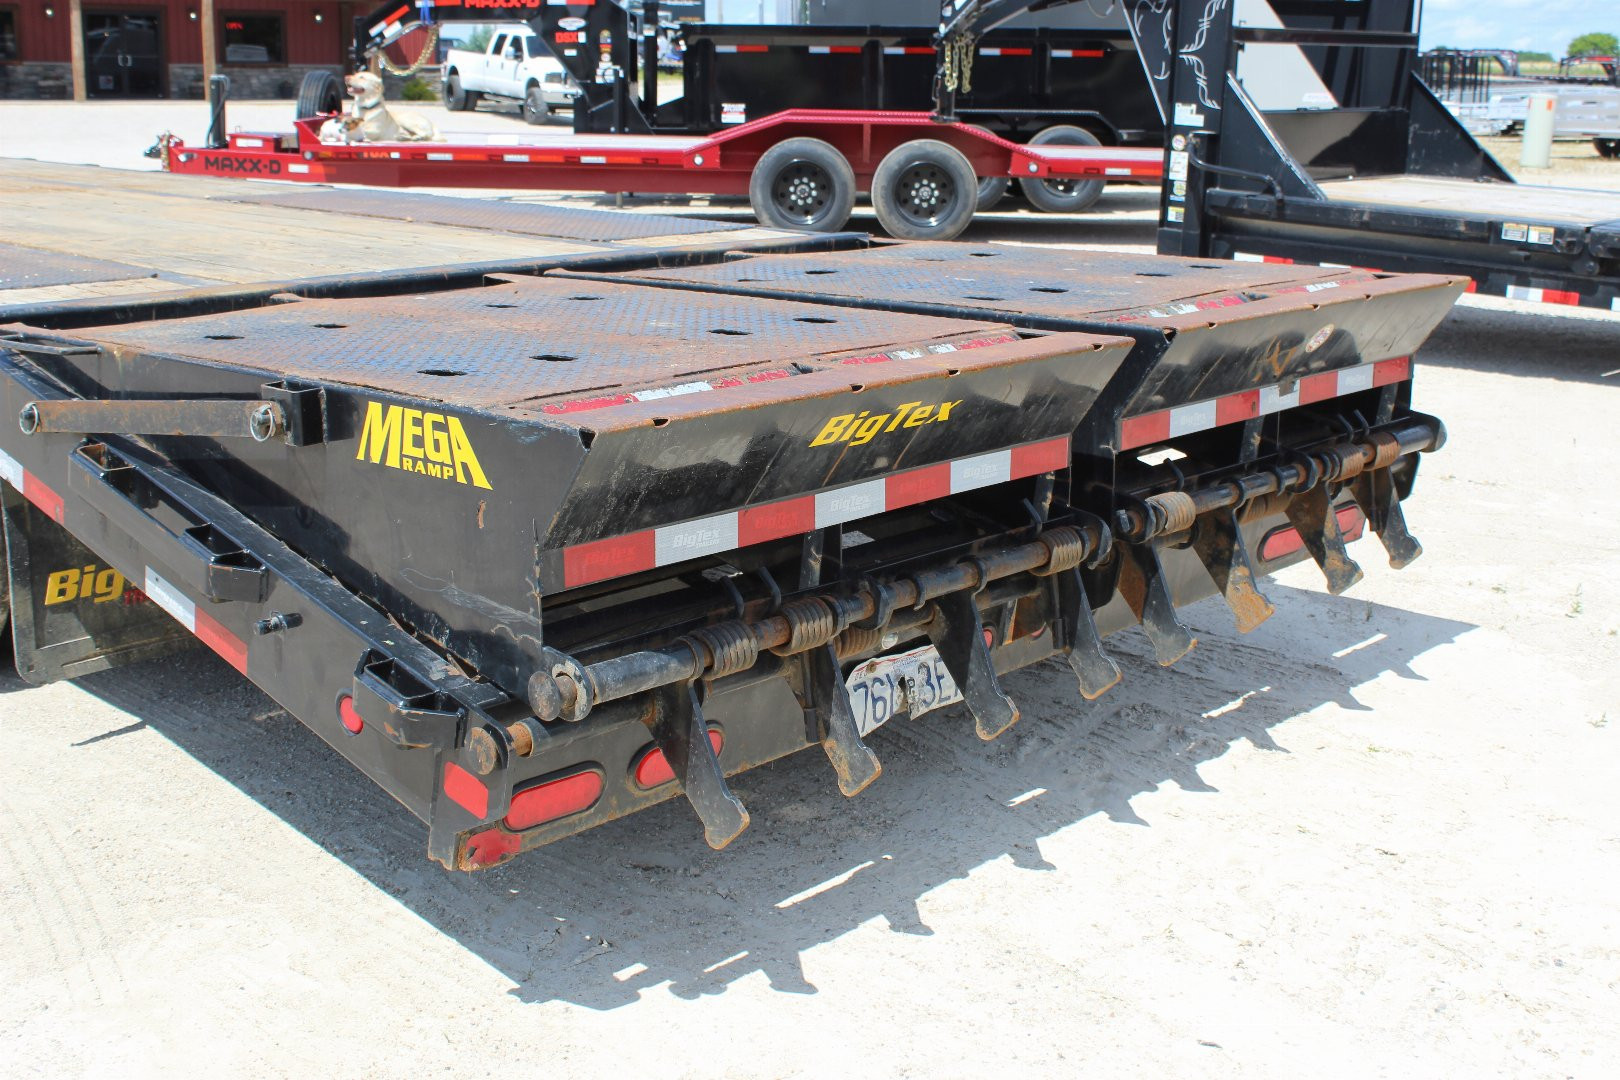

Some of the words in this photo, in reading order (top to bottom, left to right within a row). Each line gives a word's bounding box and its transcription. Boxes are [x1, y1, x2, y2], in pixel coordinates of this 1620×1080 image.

[204, 156, 281, 174] MAXX-D
[356, 401, 494, 490] MEGA
[402, 456, 454, 479] RAMP
[44, 564, 136, 606] Big
